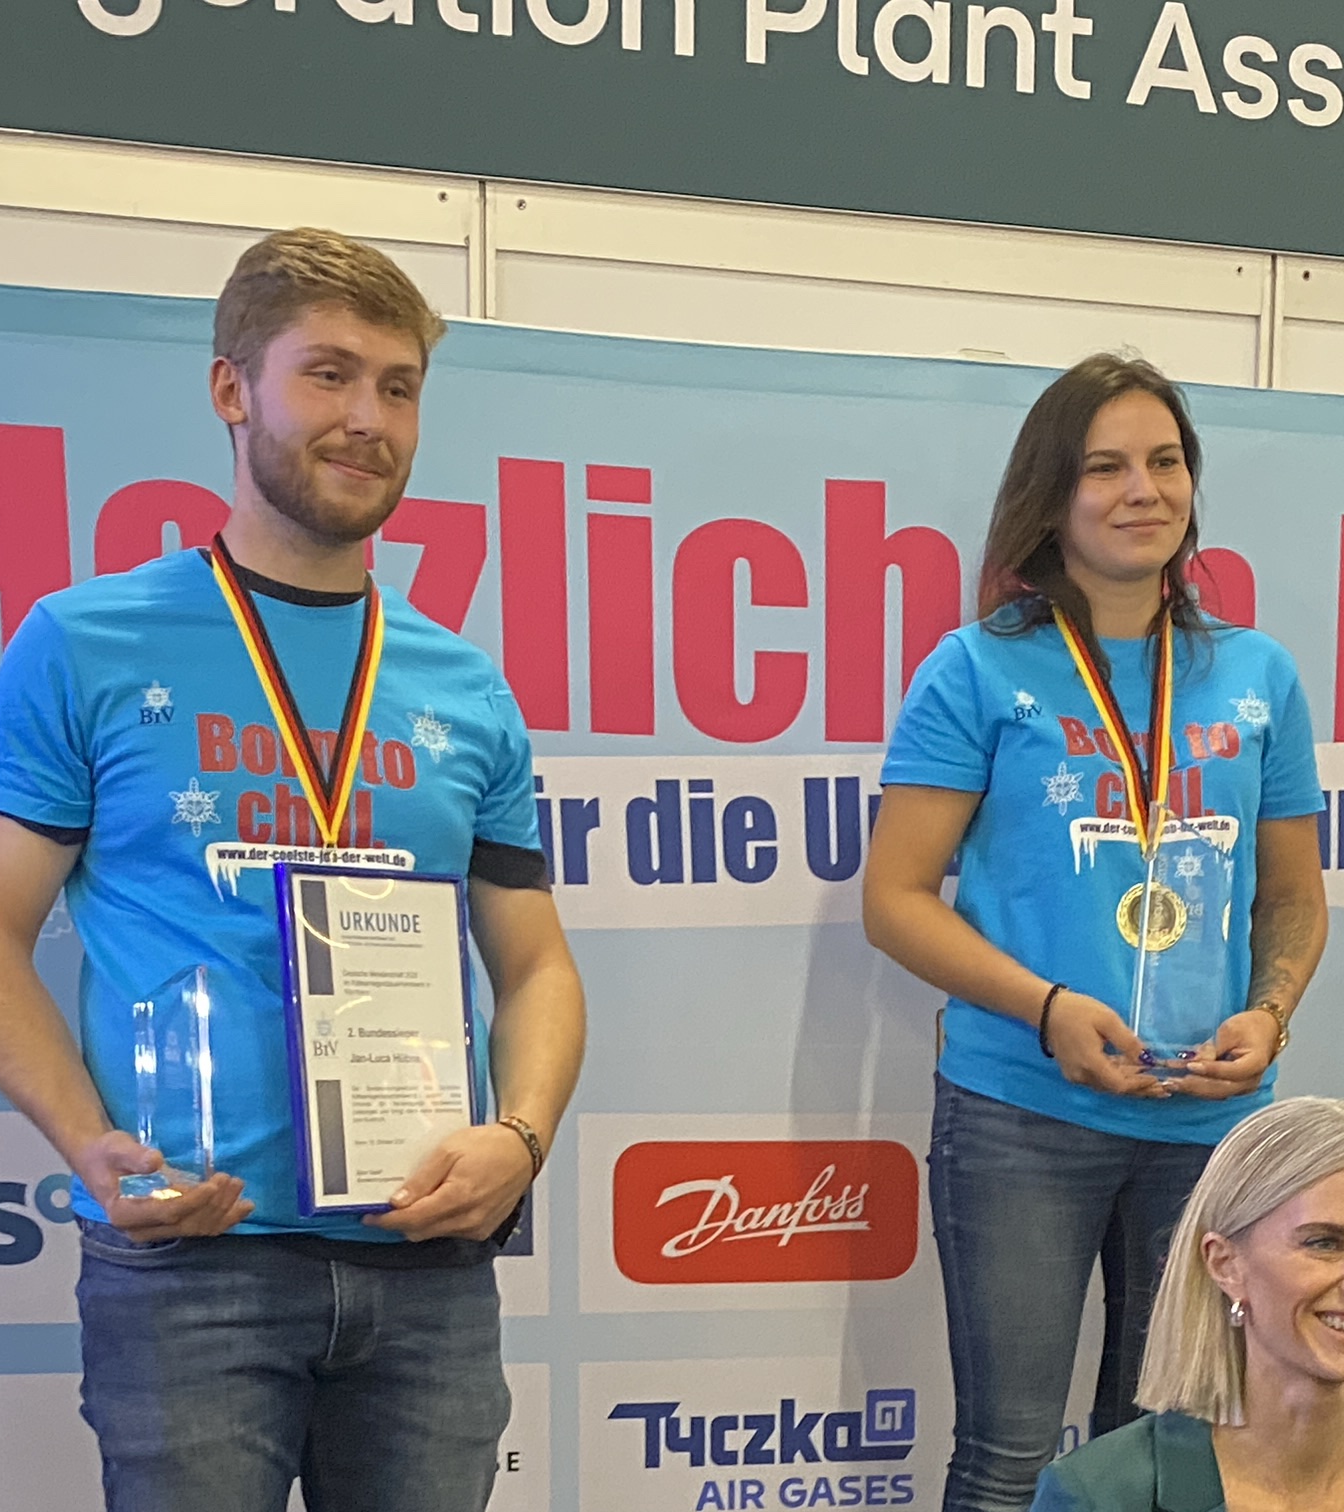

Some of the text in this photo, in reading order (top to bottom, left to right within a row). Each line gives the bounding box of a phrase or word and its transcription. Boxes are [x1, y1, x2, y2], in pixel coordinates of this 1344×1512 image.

[1184, 721, 1241, 760] to
[625, 777, 778, 885] die
[339, 910, 422, 934] URKUNDE
[655, 1163, 871, 1258] Danfoss
[695, 1473, 915, 1512] AIR GASES
